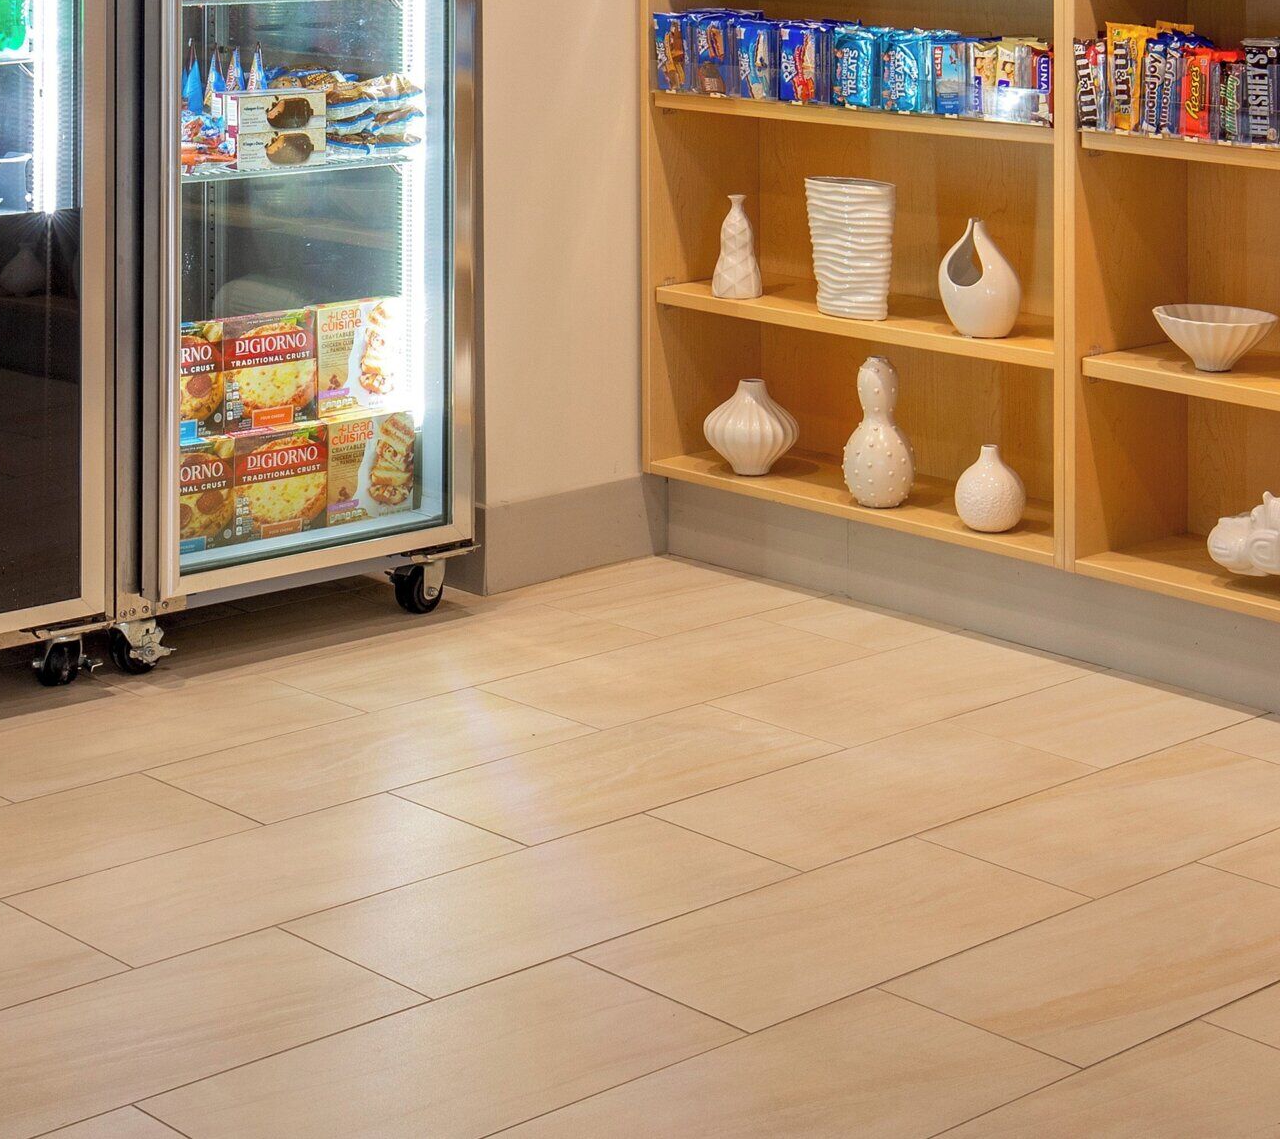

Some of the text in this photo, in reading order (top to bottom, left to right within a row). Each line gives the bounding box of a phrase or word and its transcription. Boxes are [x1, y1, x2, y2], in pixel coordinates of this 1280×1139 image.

[847, 49, 859, 95] TREATS
[895, 51, 906, 98] TREATS
[1040, 56, 1049, 91] LUNA
[1185, 65, 1201, 120] Reese's
[1246, 46, 1270, 136] HERSHEY'S
[335, 308, 362, 321] Lean
[235, 332, 307, 355] DIGIORNO
[190, 363, 215, 372] CRUST
[231, 350, 311, 367] TRADITIONAL CRUST
[347, 420, 374, 434] Lean
[247, 446, 319, 470] DIGIORNO
[242, 464, 321, 482] TRADITIONAL CRUST
[201, 480, 227, 490] CRUST
